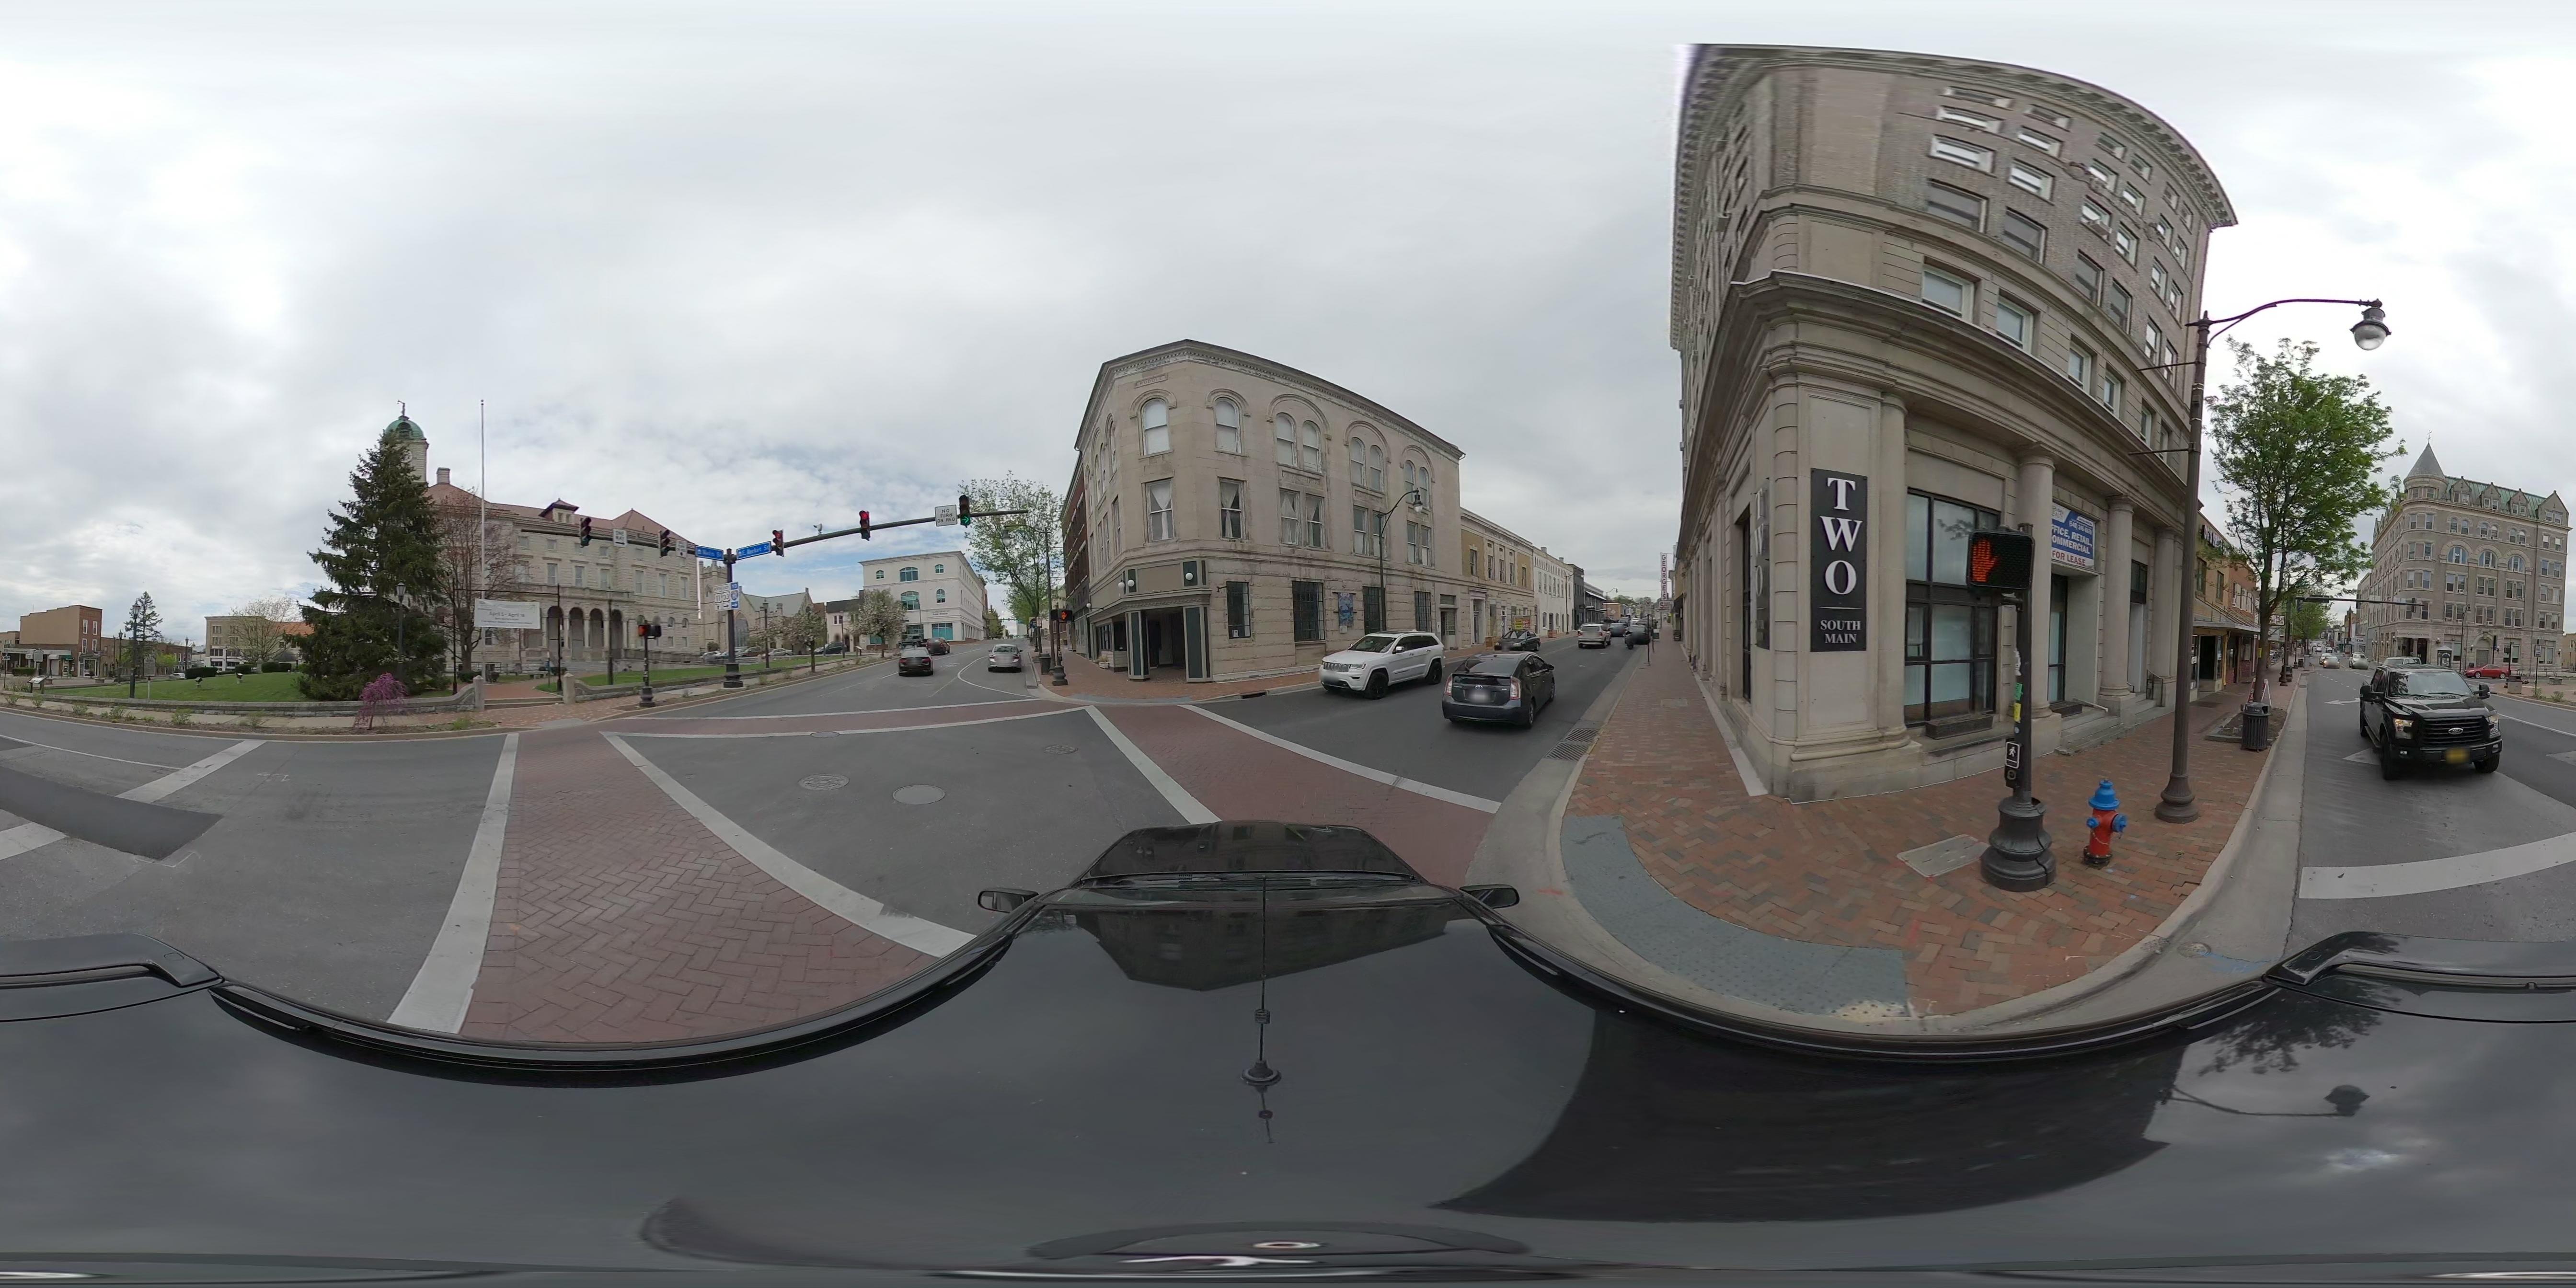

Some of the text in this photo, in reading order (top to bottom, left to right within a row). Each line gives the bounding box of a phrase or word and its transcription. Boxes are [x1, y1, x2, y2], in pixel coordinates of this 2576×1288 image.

[1819, 477, 1863, 595] TWO
[2052, 535, 2090, 554] OMMERCIAL
[2052, 550, 2086, 566] FOR LEASE
[1820, 620, 1862, 631] SOUTH
[1825, 633, 1857, 644] MAIN
